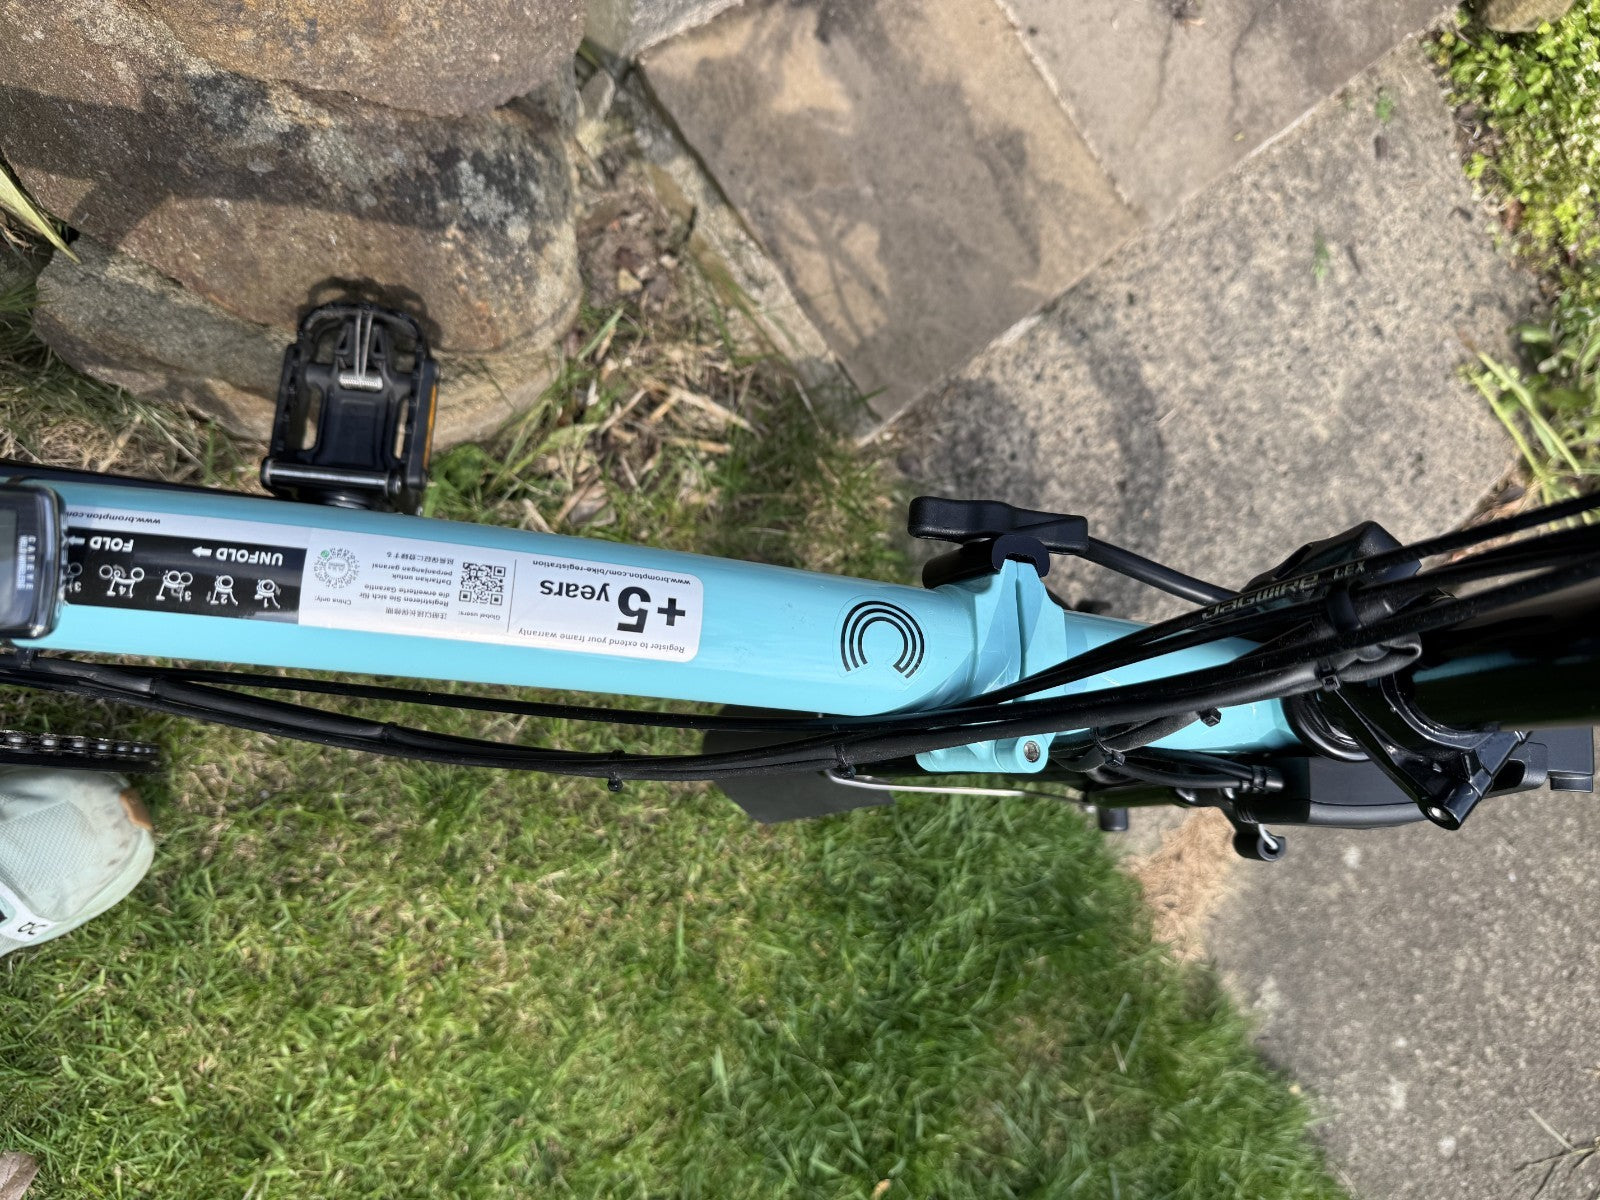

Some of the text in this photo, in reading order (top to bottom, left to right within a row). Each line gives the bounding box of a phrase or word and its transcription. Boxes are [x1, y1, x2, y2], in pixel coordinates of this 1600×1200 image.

[90, 536, 134, 552] FOLD
[216, 547, 283, 565] UNFOLD
[372, 563, 453, 577] perpanjangan garansi
[533, 560, 691, 586] www.brompton.com/bike-registration
[392, 574, 451, 585] Daftarkan untuk
[119, 586, 126, 595] 4
[364, 585, 396, 594] Garantie
[399, 588, 436, 597] erweiterte
[540, 580, 610, 603] years
[185, 591, 191, 601] 3
[221, 594, 227, 604] 2
[404, 597, 448, 607] Registrieren
[518, 628, 557, 638] warranty
[560, 633, 585, 642] frame
[588, 636, 607, 644] your
[609, 638, 637, 647] extend
[650, 642, 684, 653] Register
